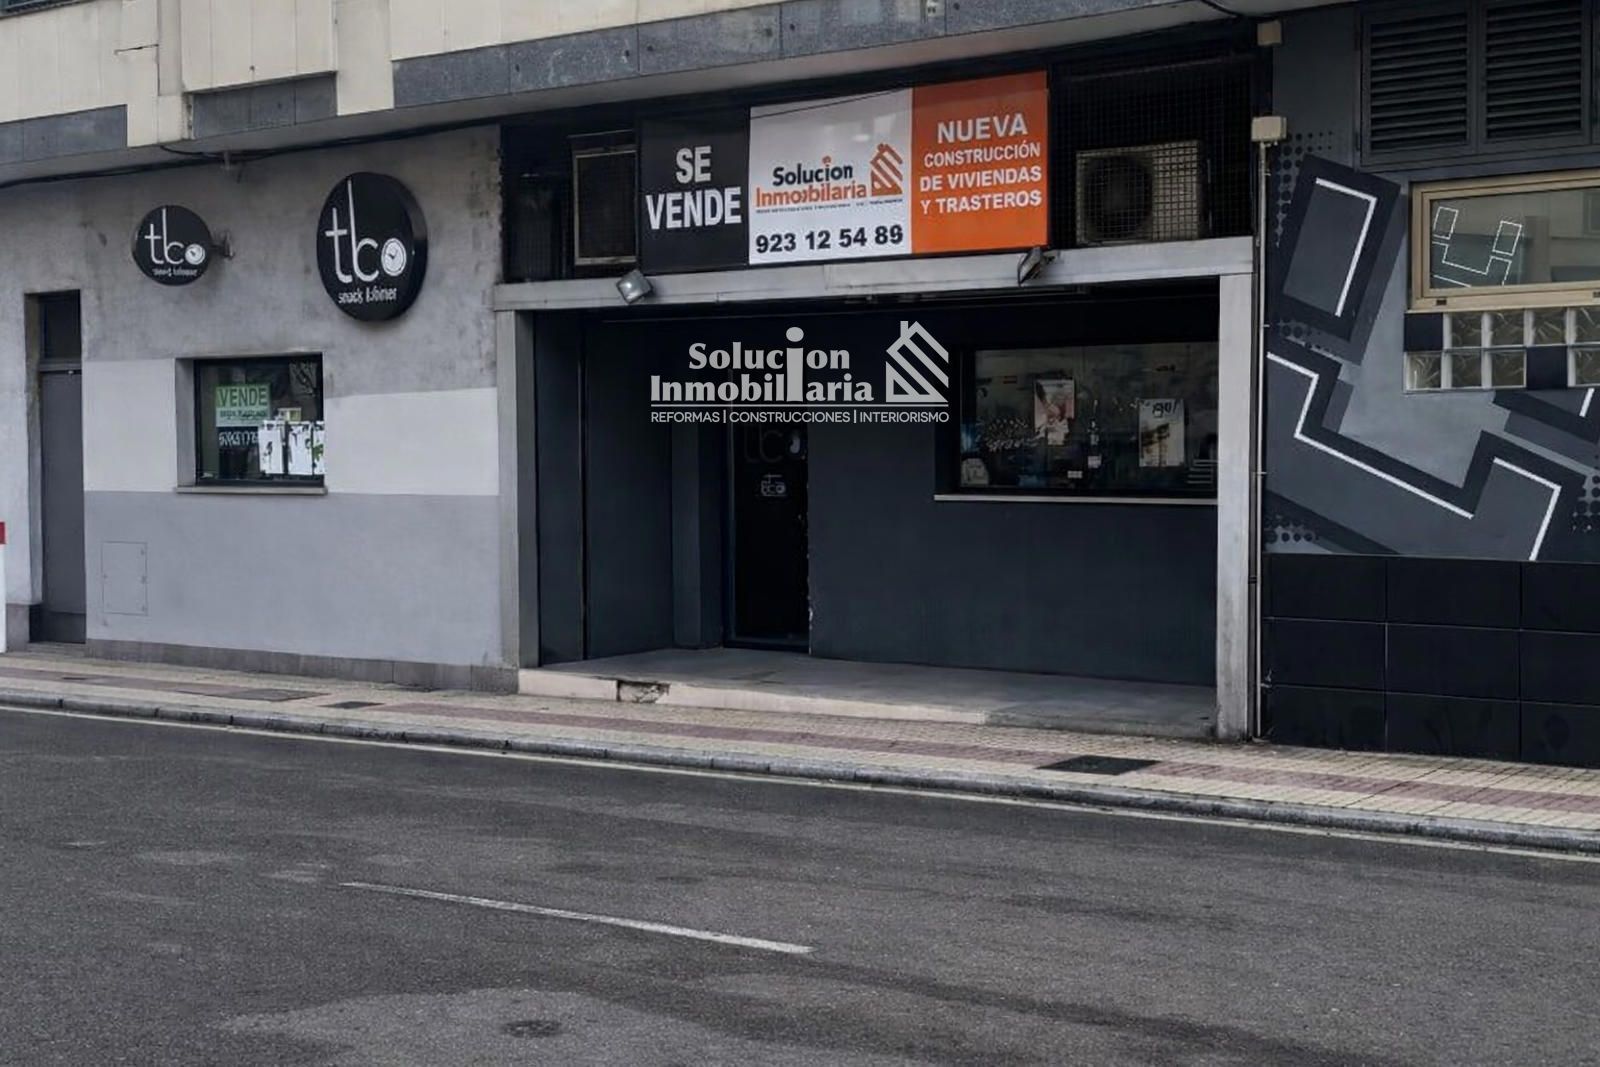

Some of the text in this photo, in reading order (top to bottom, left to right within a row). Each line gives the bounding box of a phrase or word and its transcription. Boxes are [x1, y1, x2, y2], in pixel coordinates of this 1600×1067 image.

[936, 112, 1028, 144] NUEVA
[676, 145, 712, 184] SE
[923, 140, 1041, 169] CONSTRUCCIÓN
[920, 165, 1042, 193] DE VIVIENDAS
[646, 187, 742, 230] VENDE
[920, 199, 931, 216] Y
[935, 189, 1042, 214] TRASTEROS
[756, 231, 796, 254] 923
[804, 230, 831, 250] 12
[838, 227, 867, 248] 54
[220, 387, 268, 407] VENDE
